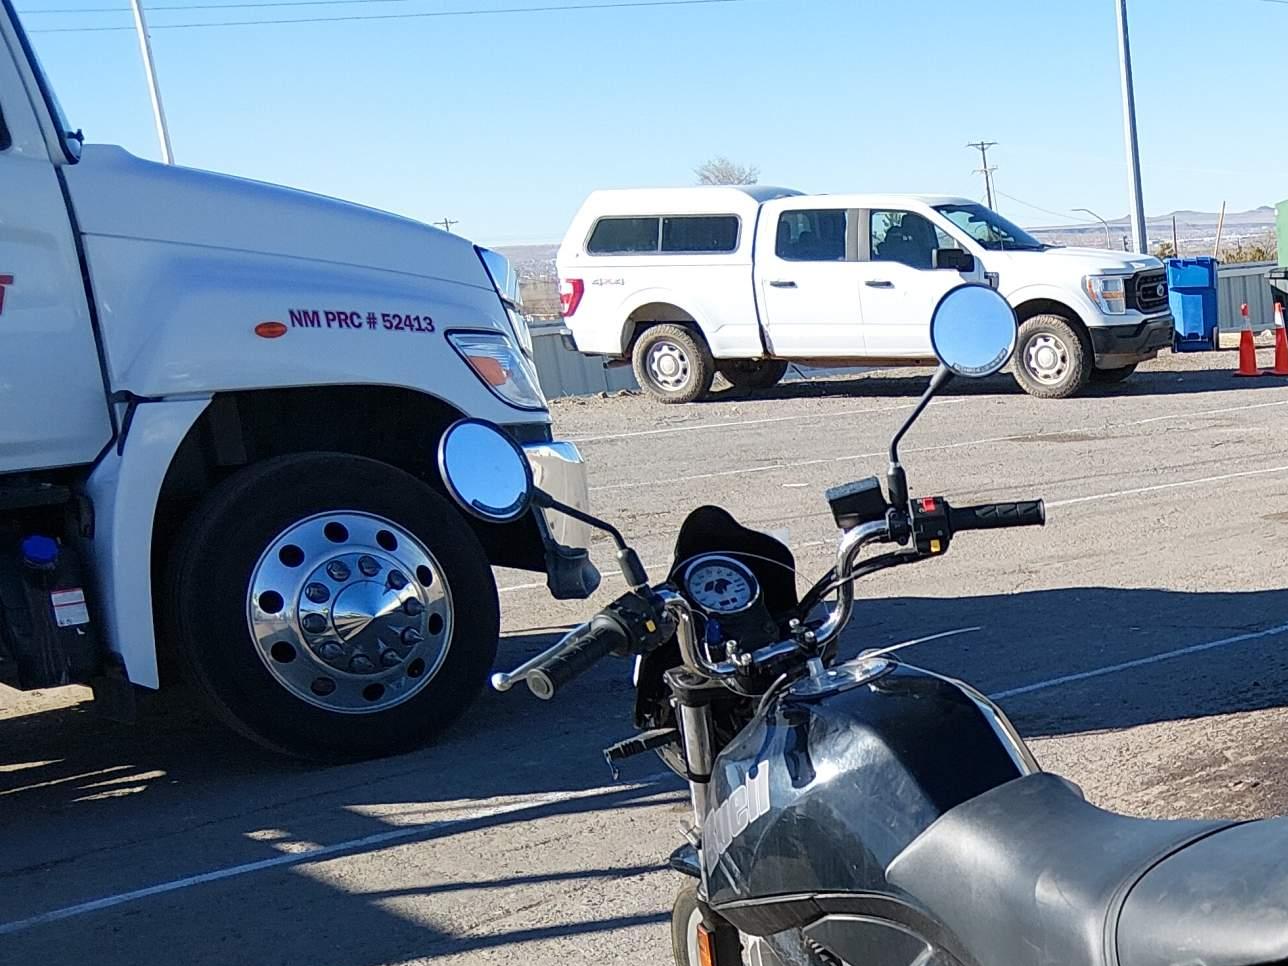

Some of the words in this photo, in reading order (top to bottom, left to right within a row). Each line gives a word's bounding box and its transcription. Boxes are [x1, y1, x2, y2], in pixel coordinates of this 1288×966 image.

[288, 309, 321, 328] NM
[324, 310, 363, 329] PRC
[366, 312, 377, 330] #
[381, 313, 435, 333] 52413
